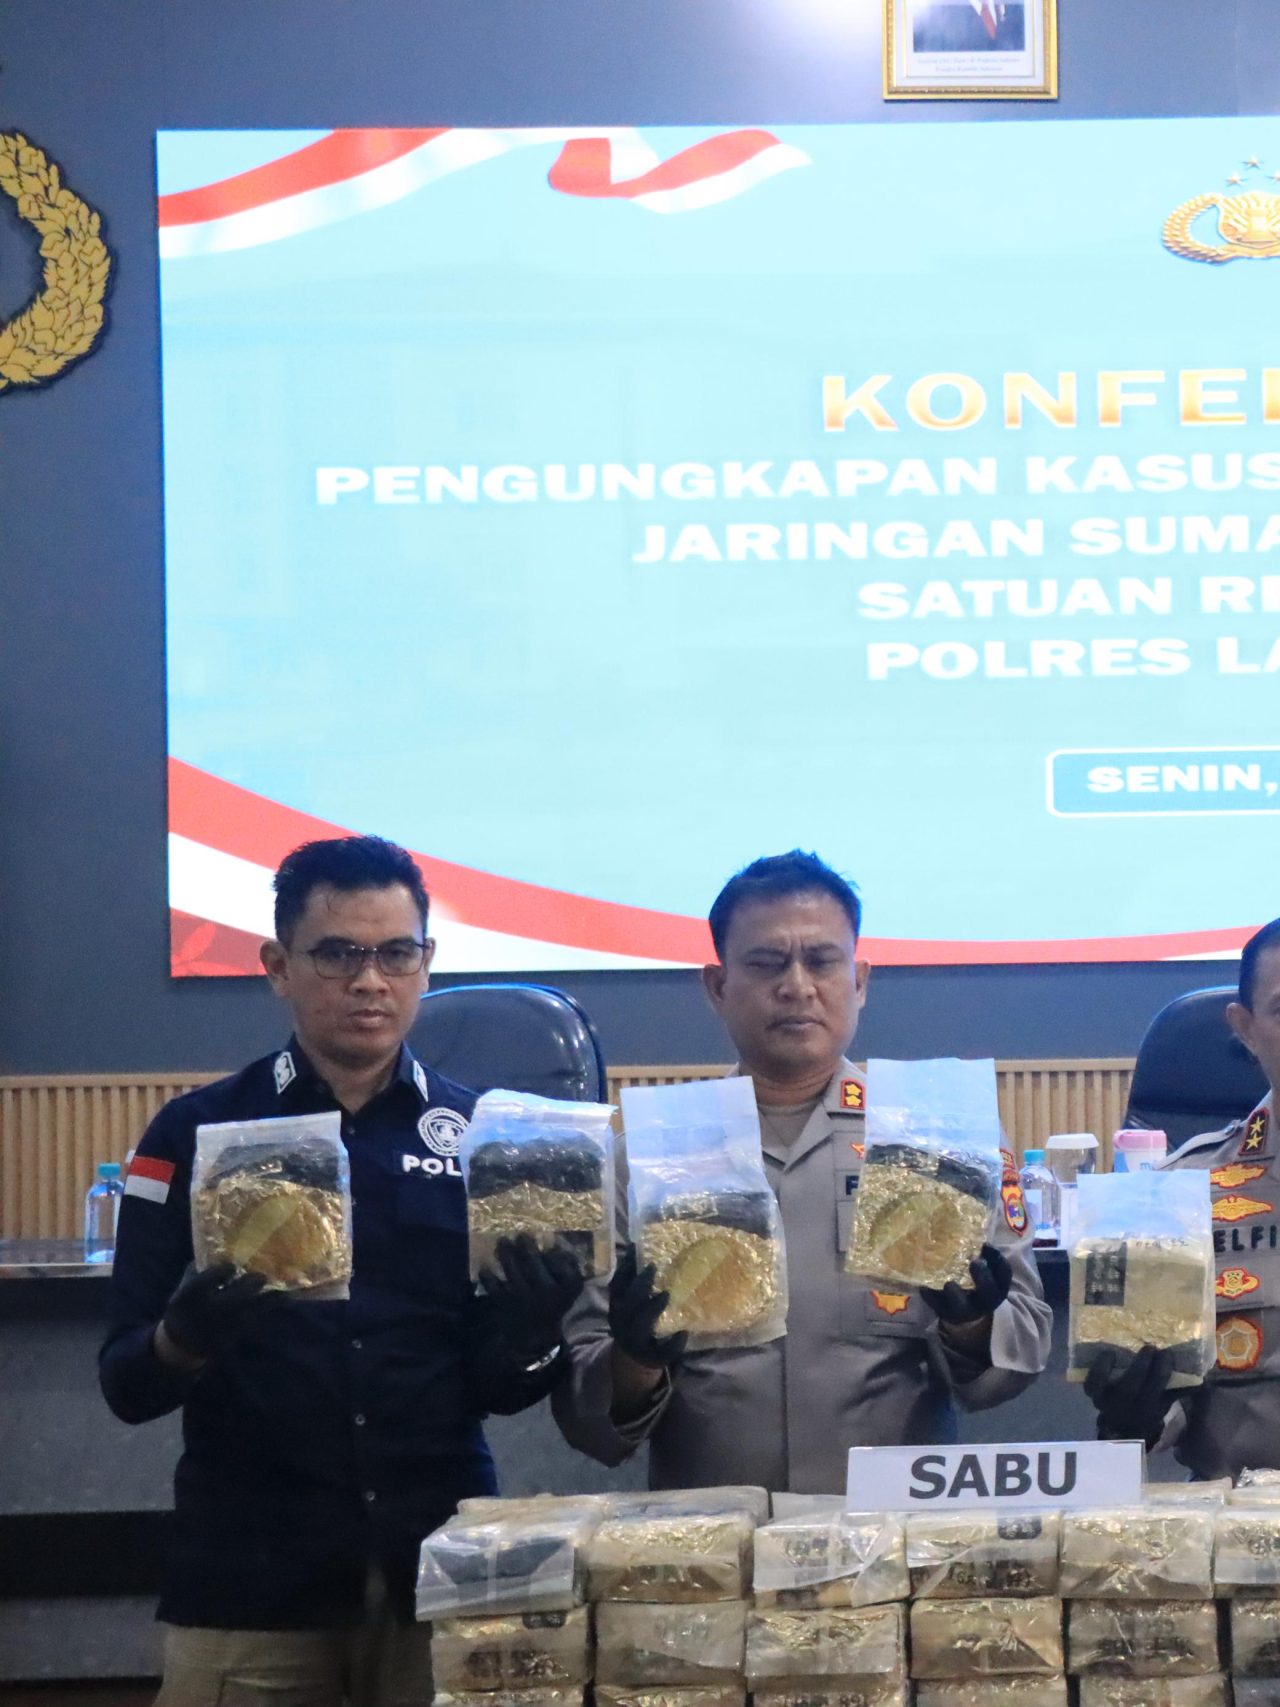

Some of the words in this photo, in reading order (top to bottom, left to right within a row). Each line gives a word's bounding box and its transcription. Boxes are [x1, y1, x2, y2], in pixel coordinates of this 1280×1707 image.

[318, 458, 998, 504] PENGUNGKAPAN
[635, 520, 1044, 563] JARINGAN
[860, 578, 1173, 620] SATUAN
[869, 639, 1191, 680] POLRES
[1089, 765, 1278, 795] SENIN,
[402, 1154, 463, 1177] POL
[1214, 1225, 1278, 1252] ELFI
[909, 1451, 1078, 1500] SABU
